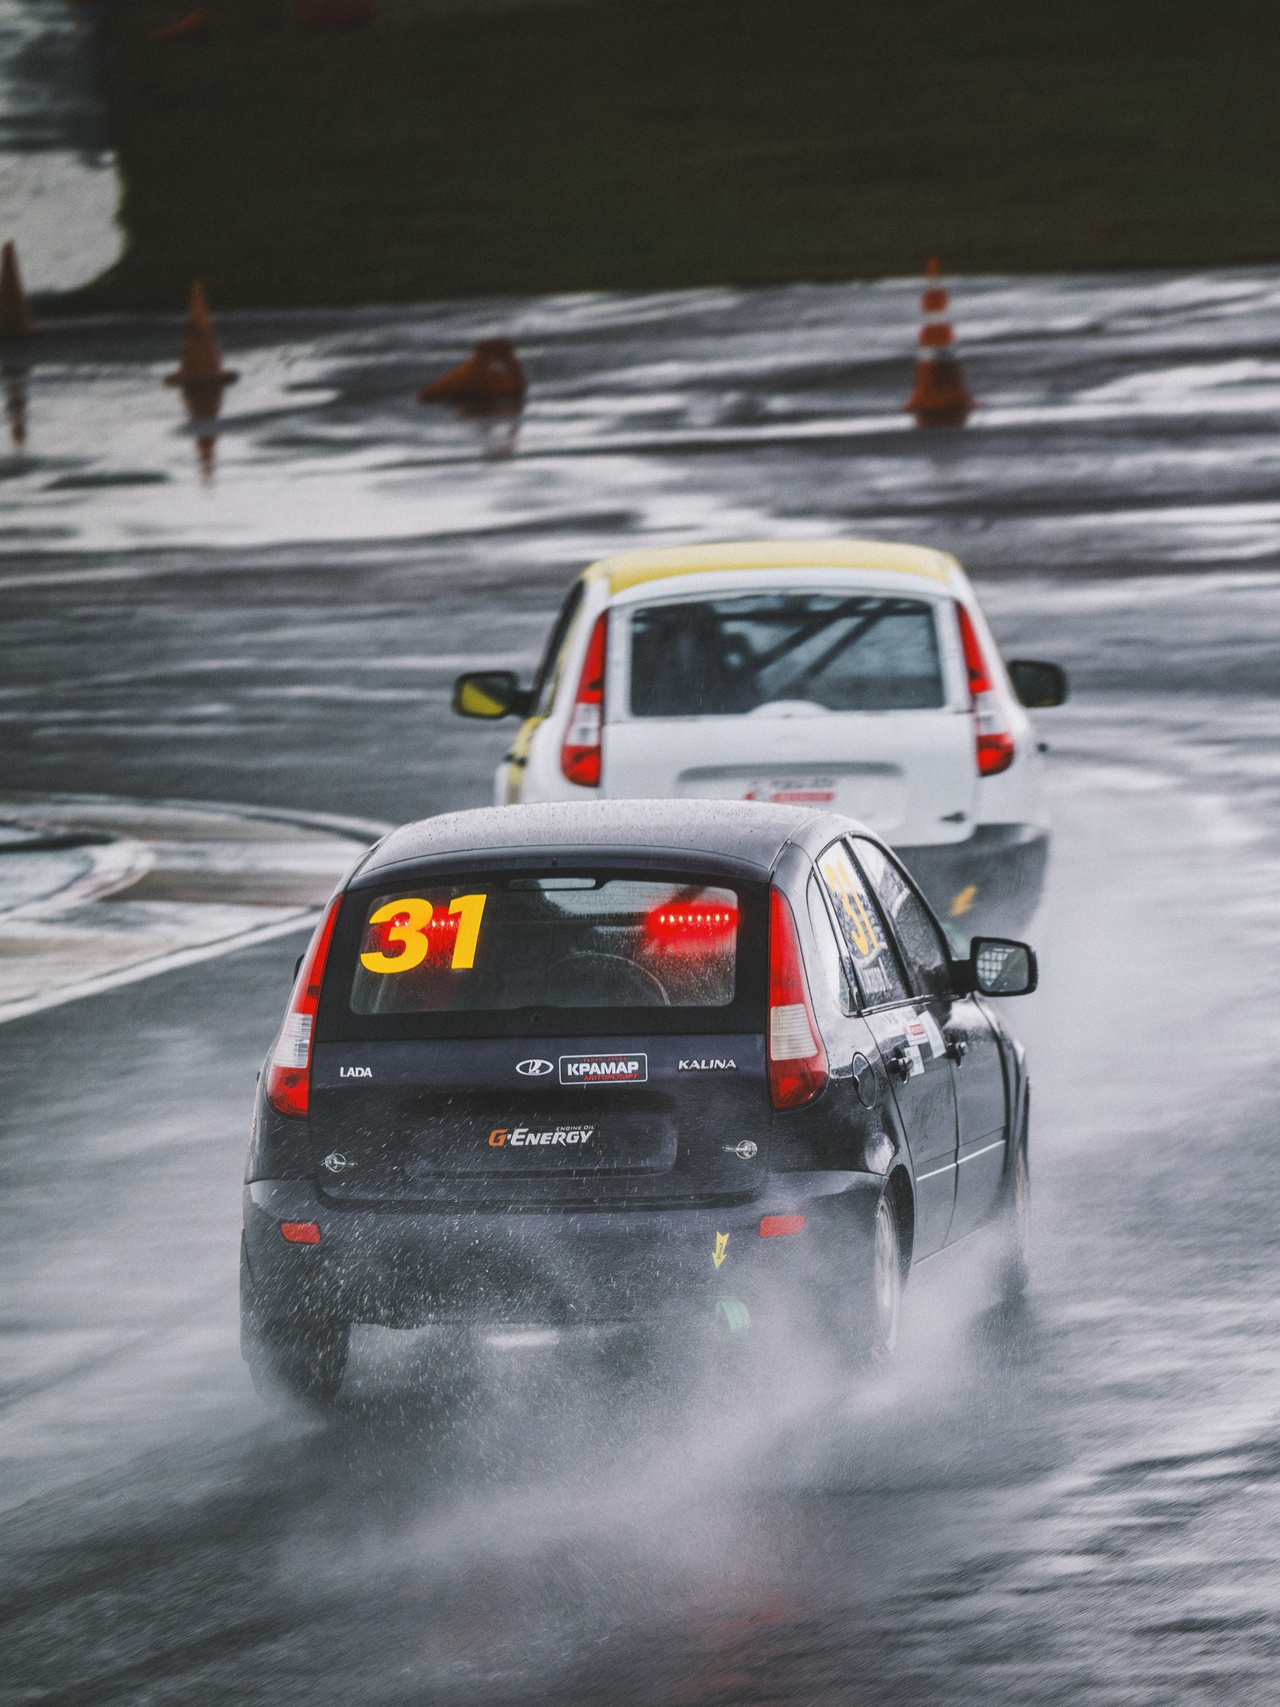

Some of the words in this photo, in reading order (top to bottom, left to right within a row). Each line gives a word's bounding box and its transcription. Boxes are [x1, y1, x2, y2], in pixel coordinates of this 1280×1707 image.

[360, 894, 487, 974] 31
[567, 1061, 639, 1076] КРАМАР
[678, 1059, 737, 1070] KALINA
[340, 1066, 373, 1078] LADA
[584, 1073, 639, 1081] МОТОРСПОРТ
